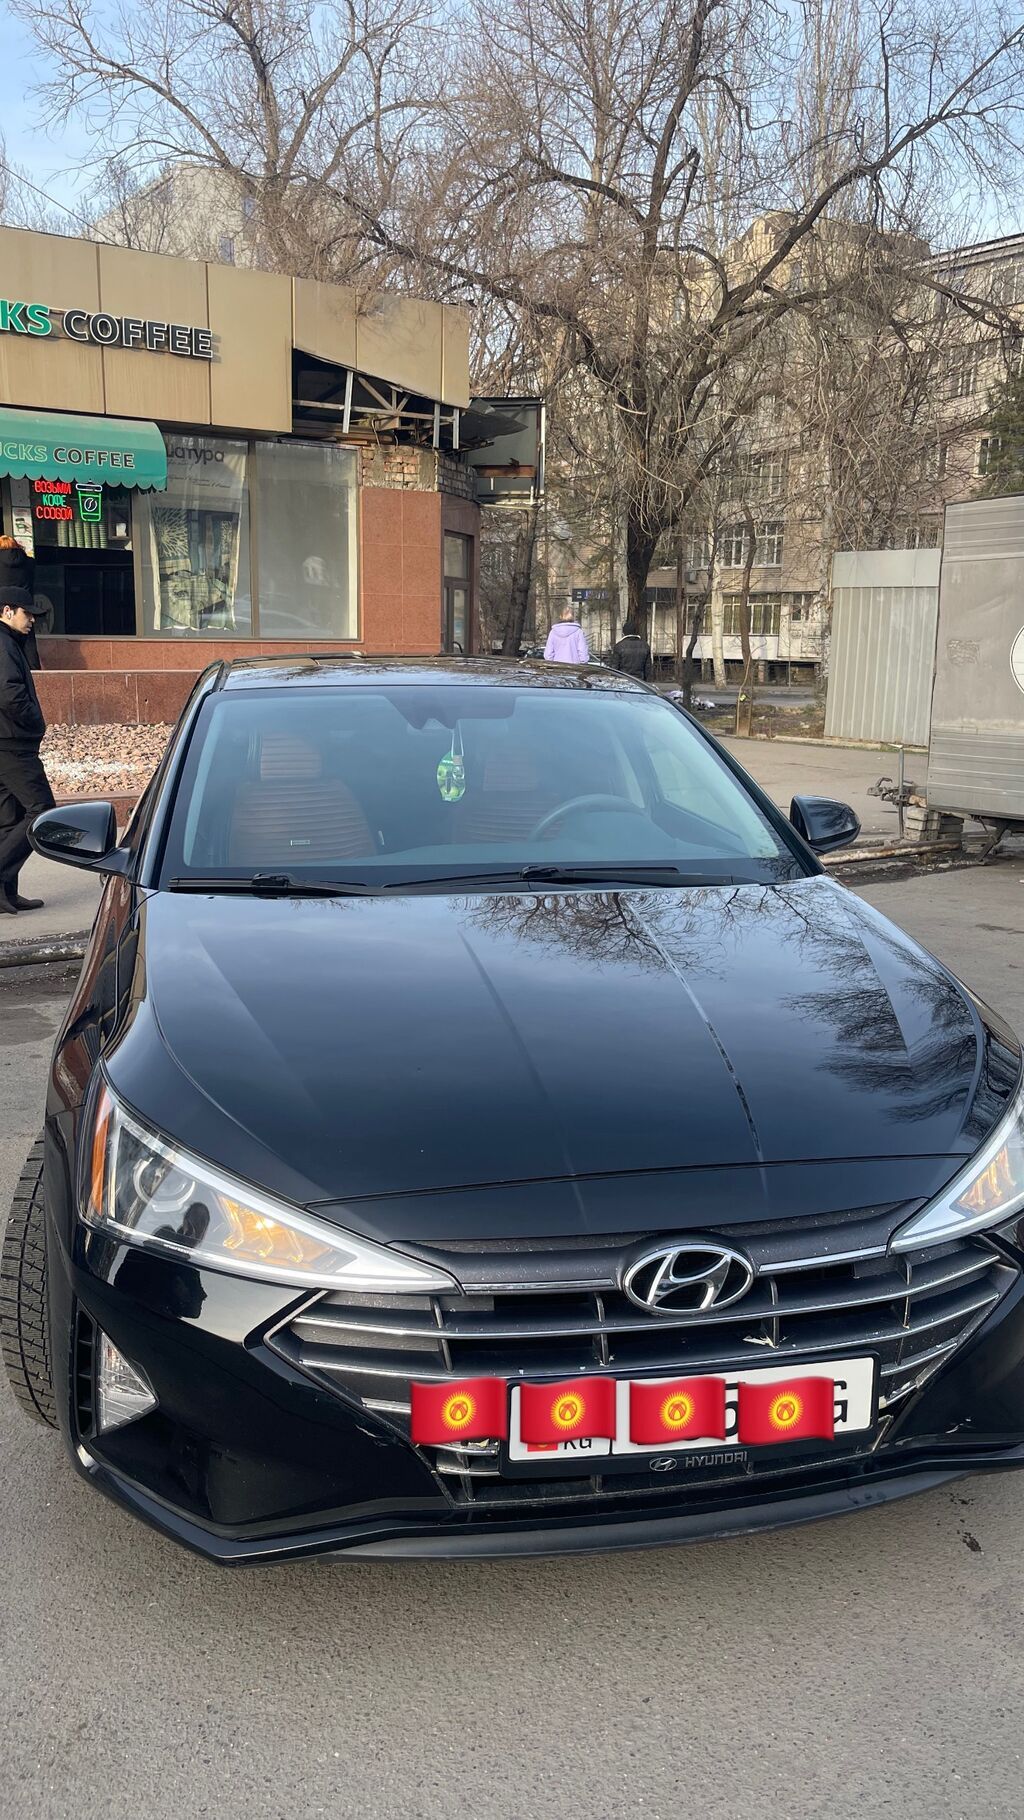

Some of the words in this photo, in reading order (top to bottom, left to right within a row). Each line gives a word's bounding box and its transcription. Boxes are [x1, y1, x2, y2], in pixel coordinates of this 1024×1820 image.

[62, 308, 214, 358] COFFEE
[0, 441, 48, 462] CKS
[53, 446, 136, 469] COFFEE
[34, 480, 72, 494] ВОЗЬМИ
[42, 494, 67, 507] КОФЕ
[685, 1451, 748, 1468] HYUNDAI
